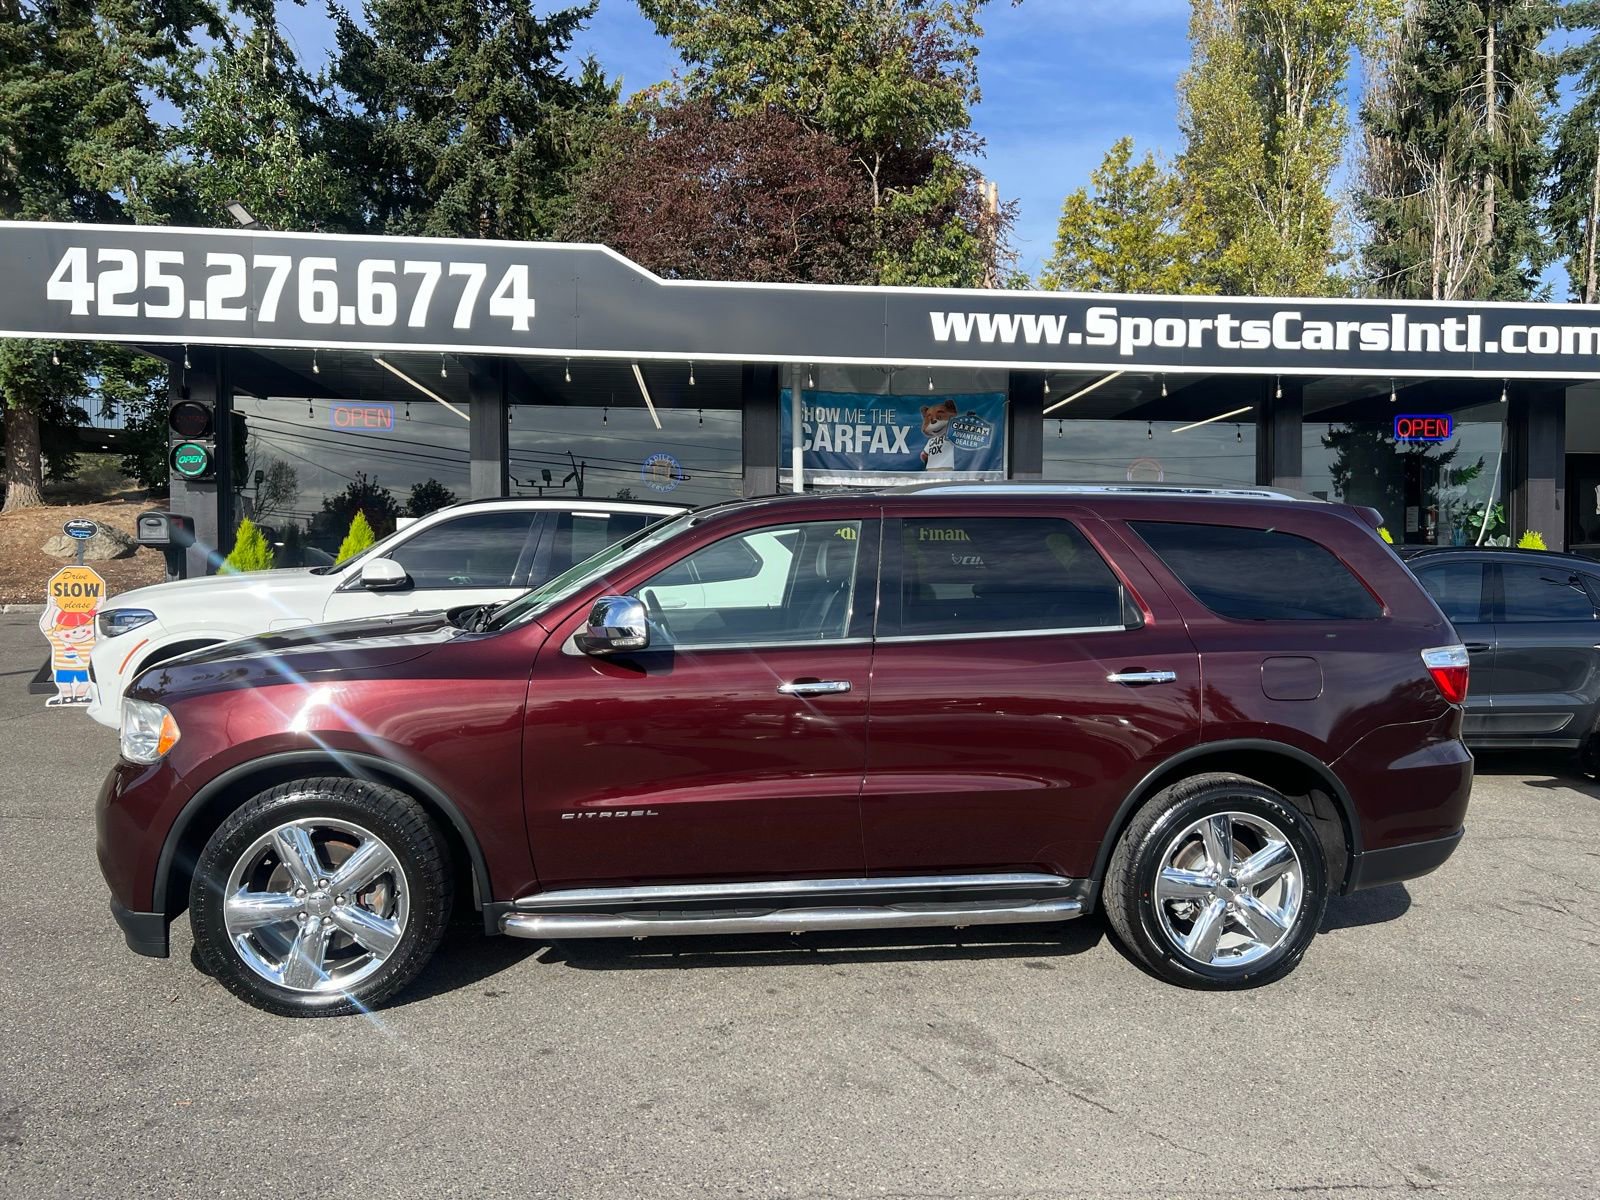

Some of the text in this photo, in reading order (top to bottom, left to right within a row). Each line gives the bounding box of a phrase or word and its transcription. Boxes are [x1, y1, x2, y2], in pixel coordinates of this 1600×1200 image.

[46, 246, 536, 331] 425.276.6774
[929, 305, 1600, 356] www.SportsCarsIntl.com
[335, 407, 391, 428] OPEN
[844, 408, 866, 424] ME
[871, 408, 897, 425] THE
[952, 422, 990, 436] CARFAX
[1397, 418, 1449, 438] OPEN
[929, 436, 944, 447] CAR
[952, 431, 985, 443] ADVANTAGE
[955, 438, 978, 448] DEALER
[929, 445, 943, 456] FOX
[178, 455, 204, 464] OPEN
[63, 571, 88, 580] Drive
[54, 583, 99, 597] SLOW
[64, 600, 90, 609] please
[561, 810, 658, 819] CITADEL
